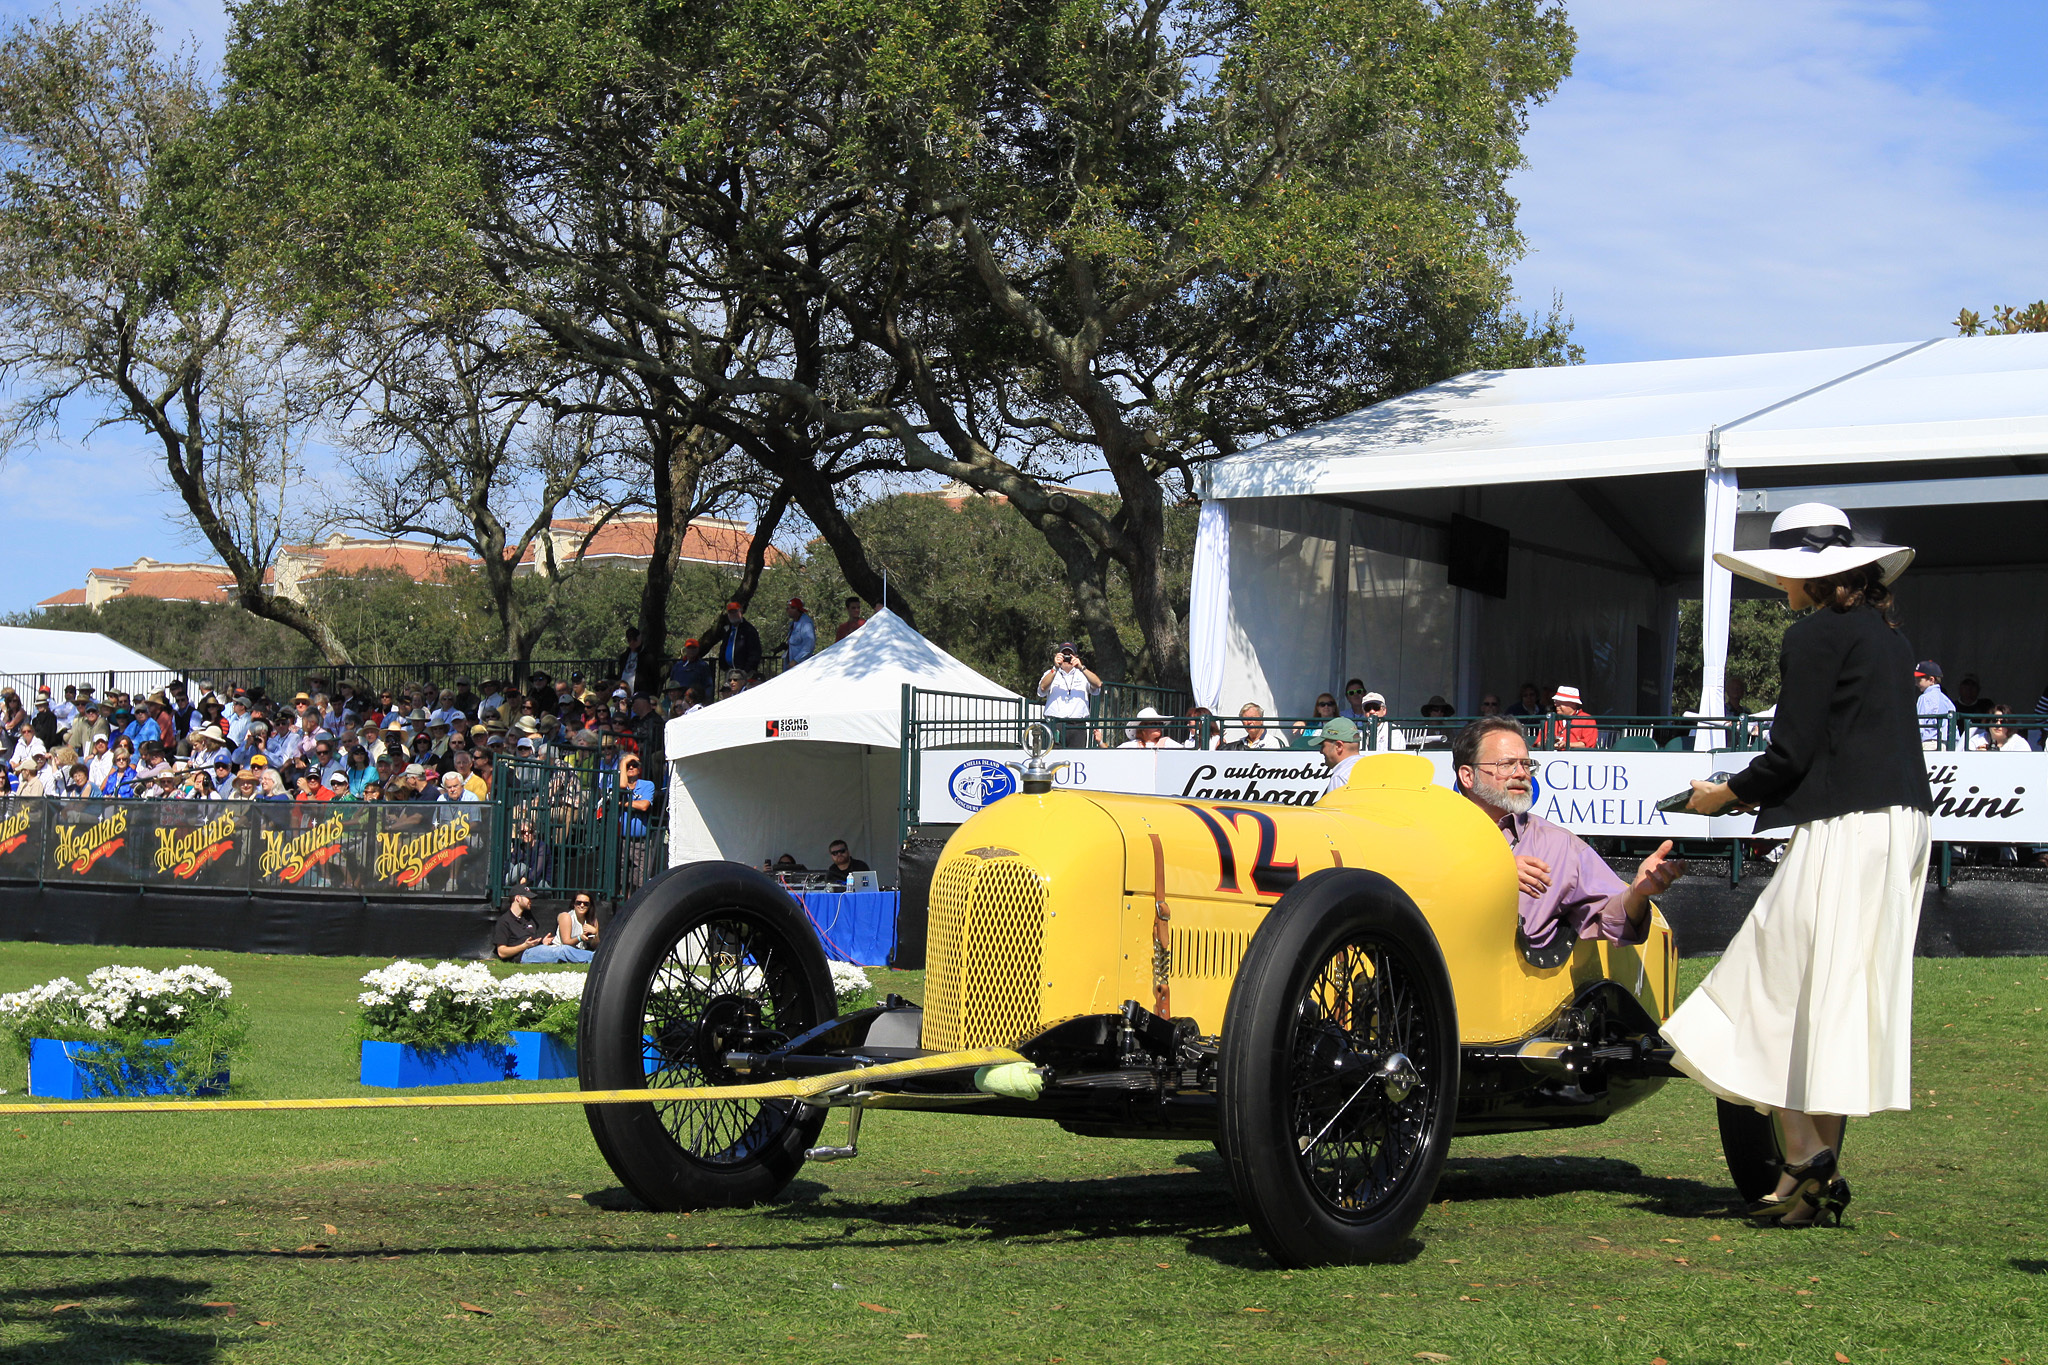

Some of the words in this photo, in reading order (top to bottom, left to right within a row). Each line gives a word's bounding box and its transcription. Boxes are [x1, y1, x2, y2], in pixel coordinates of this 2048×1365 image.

[1172, 764, 1330, 807] Lamborg
[1223, 762, 1334, 780] automobil
[1545, 760, 1629, 791] CLUB
[1544, 794, 1670, 826] AMELIA
[1930, 786, 2024, 819] hini
[54, 806, 128, 872] Meguiar's
[154, 808, 235, 876] Meguiar's
[259, 810, 344, 880] Meguiar's
[374, 810, 470, 884] Meguiar's
[1173, 802, 1301, 897] 12
